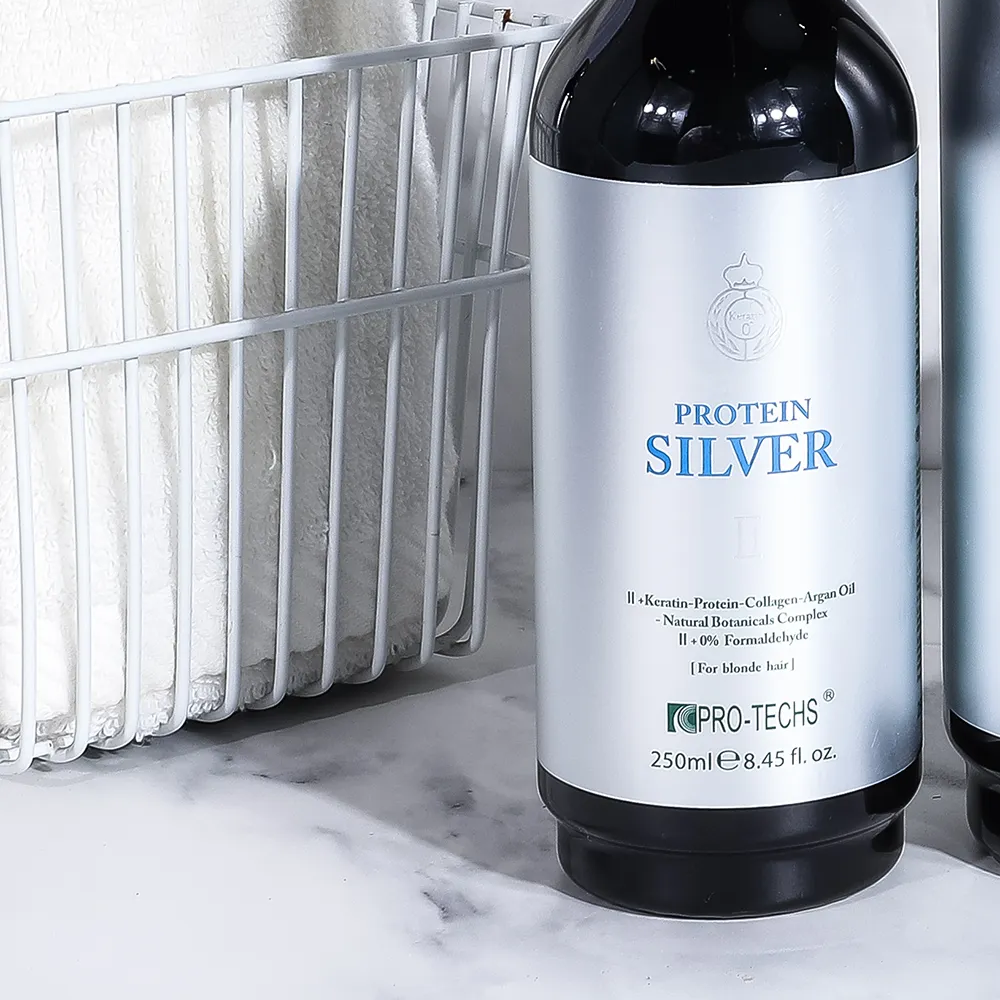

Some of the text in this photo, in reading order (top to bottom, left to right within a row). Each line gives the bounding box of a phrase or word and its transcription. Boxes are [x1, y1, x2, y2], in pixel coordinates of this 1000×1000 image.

[675, 398, 811, 425] PROTEIN
[646, 429, 837, 477] SILVER
[838, 582, 855, 597] Oil
[711, 616, 774, 628] Botanicals
[777, 610, 828, 626] Complex
[724, 630, 809, 646] Formaldehyde
[723, 662, 762, 674] blonde
[651, 751, 712, 770] 250ml
[743, 750, 785, 770] 8.45
[790, 747, 806, 764] fl.
[812, 746, 836, 762] oz.
